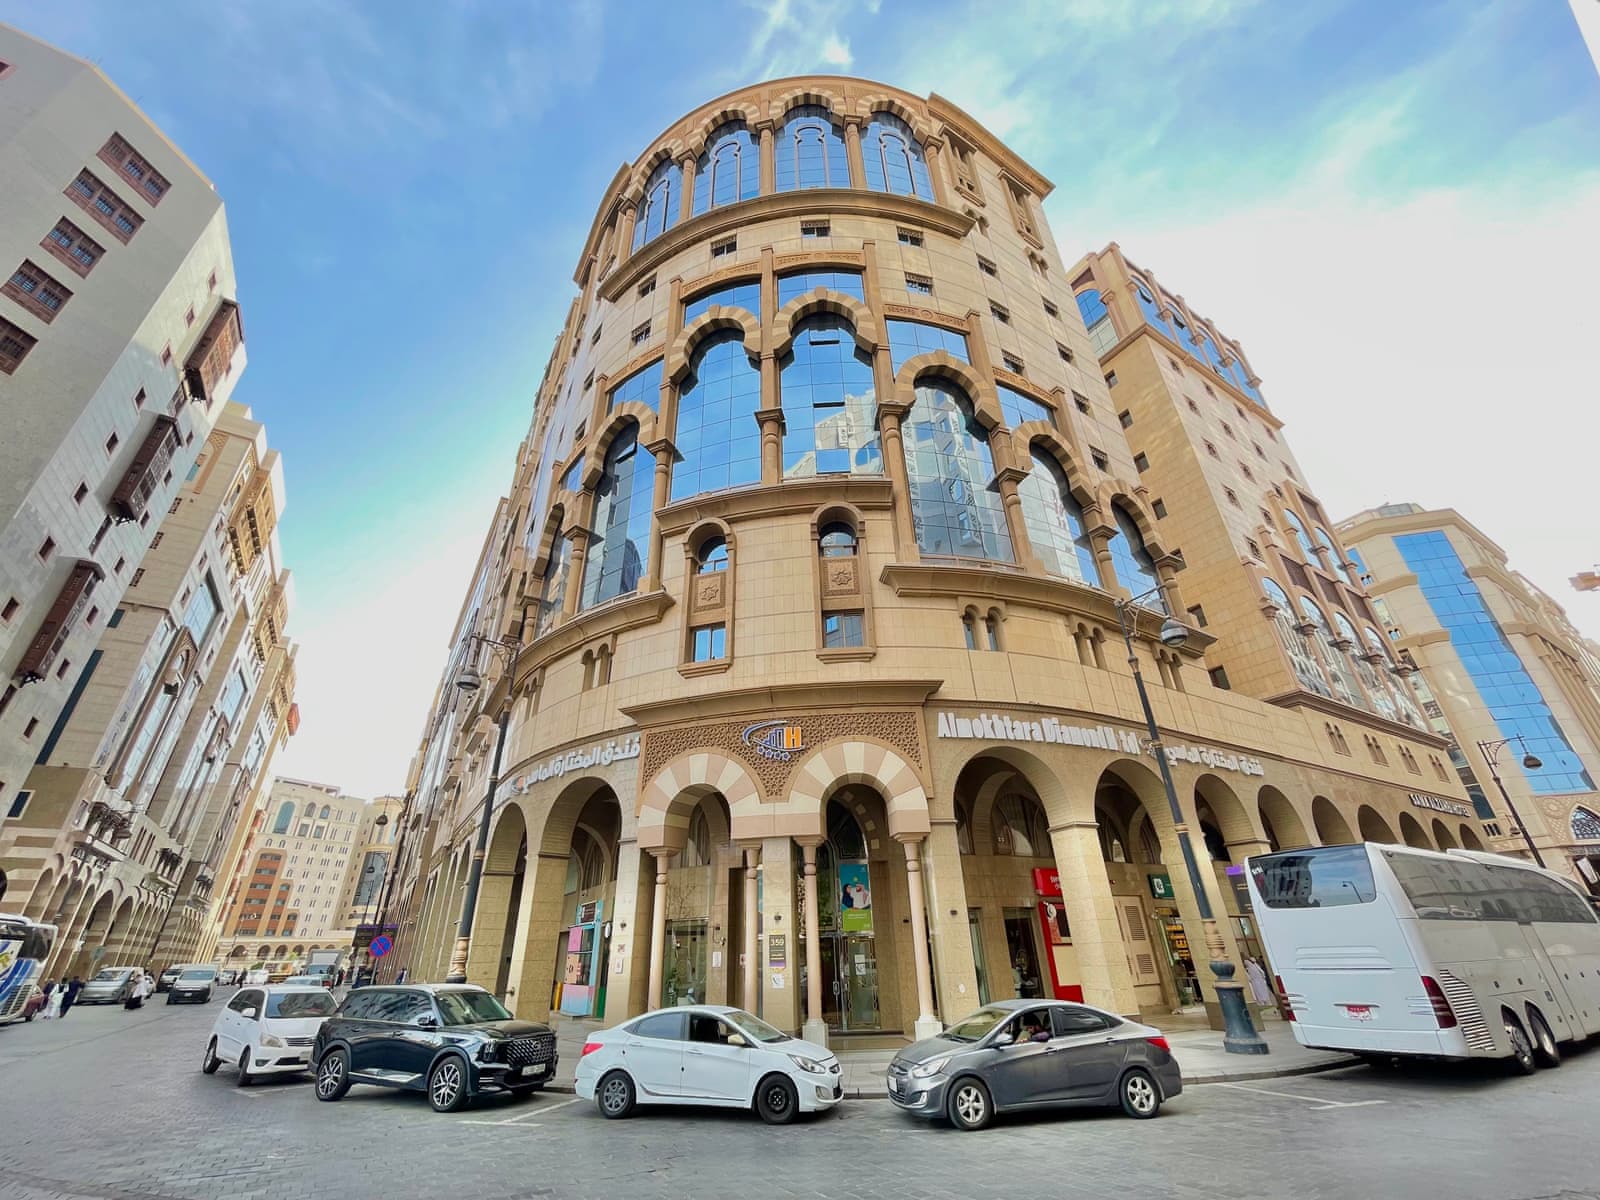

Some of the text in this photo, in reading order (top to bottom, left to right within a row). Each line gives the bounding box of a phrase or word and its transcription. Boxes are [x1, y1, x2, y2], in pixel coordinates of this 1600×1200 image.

[937, 712, 1141, 755] Almokhtara Diamond Htel
[553, 747, 601, 777] المختارة
[601, 735, 640, 766] فندق
[1238, 755, 1264, 776] فندق
